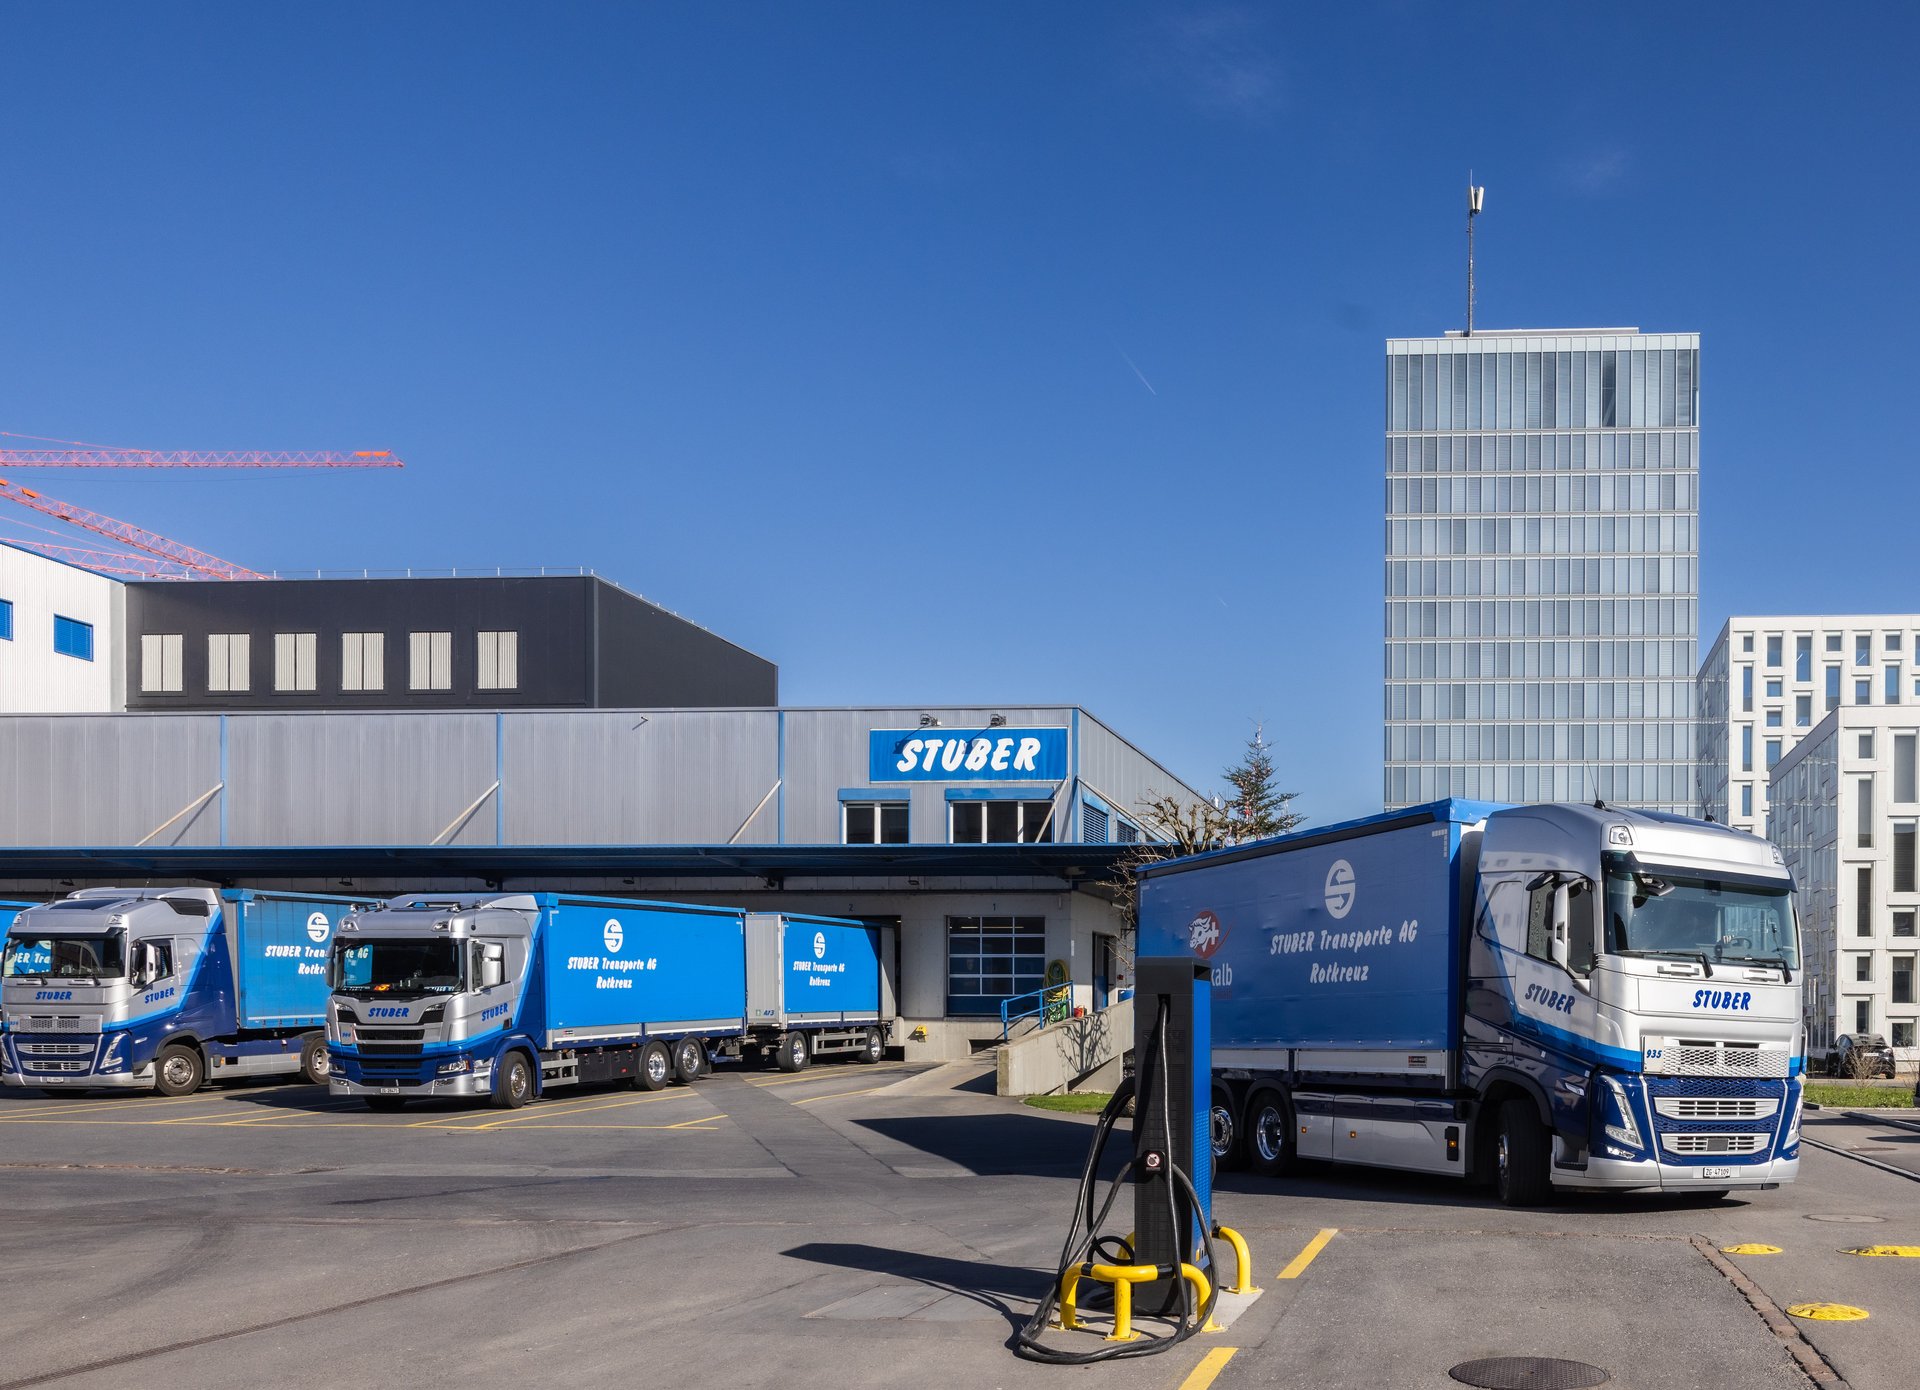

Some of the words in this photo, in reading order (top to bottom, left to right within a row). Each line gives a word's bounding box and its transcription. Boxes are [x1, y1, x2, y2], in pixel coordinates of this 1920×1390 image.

[896, 737, 1041, 773] STUBER
[1270, 931, 1315, 955] STUBER
[1320, 925, 1393, 953] Transporte
[1398, 919, 1418, 943] AG
[265, 945, 302, 958] STUBER
[298, 962, 326, 975] Rotkr
[567, 956, 600, 970] STUBER
[602, 957, 645, 973] Transporte
[646, 958, 657, 970] AG
[793, 960, 812, 971] STUBER
[1310, 961, 1370, 984] Rotkreuz
[596, 975, 633, 989] Rotkreuz
[35, 991, 73, 1000] STUBER
[145, 987, 175, 1004] STUBER
[1525, 983, 1576, 1015] STUBER
[1692, 989, 1752, 1011] STUBER
[368, 1007, 410, 1018] STUBER
[481, 1002, 508, 1022] STUBER
[1646, 1048, 1662, 1059] 935
